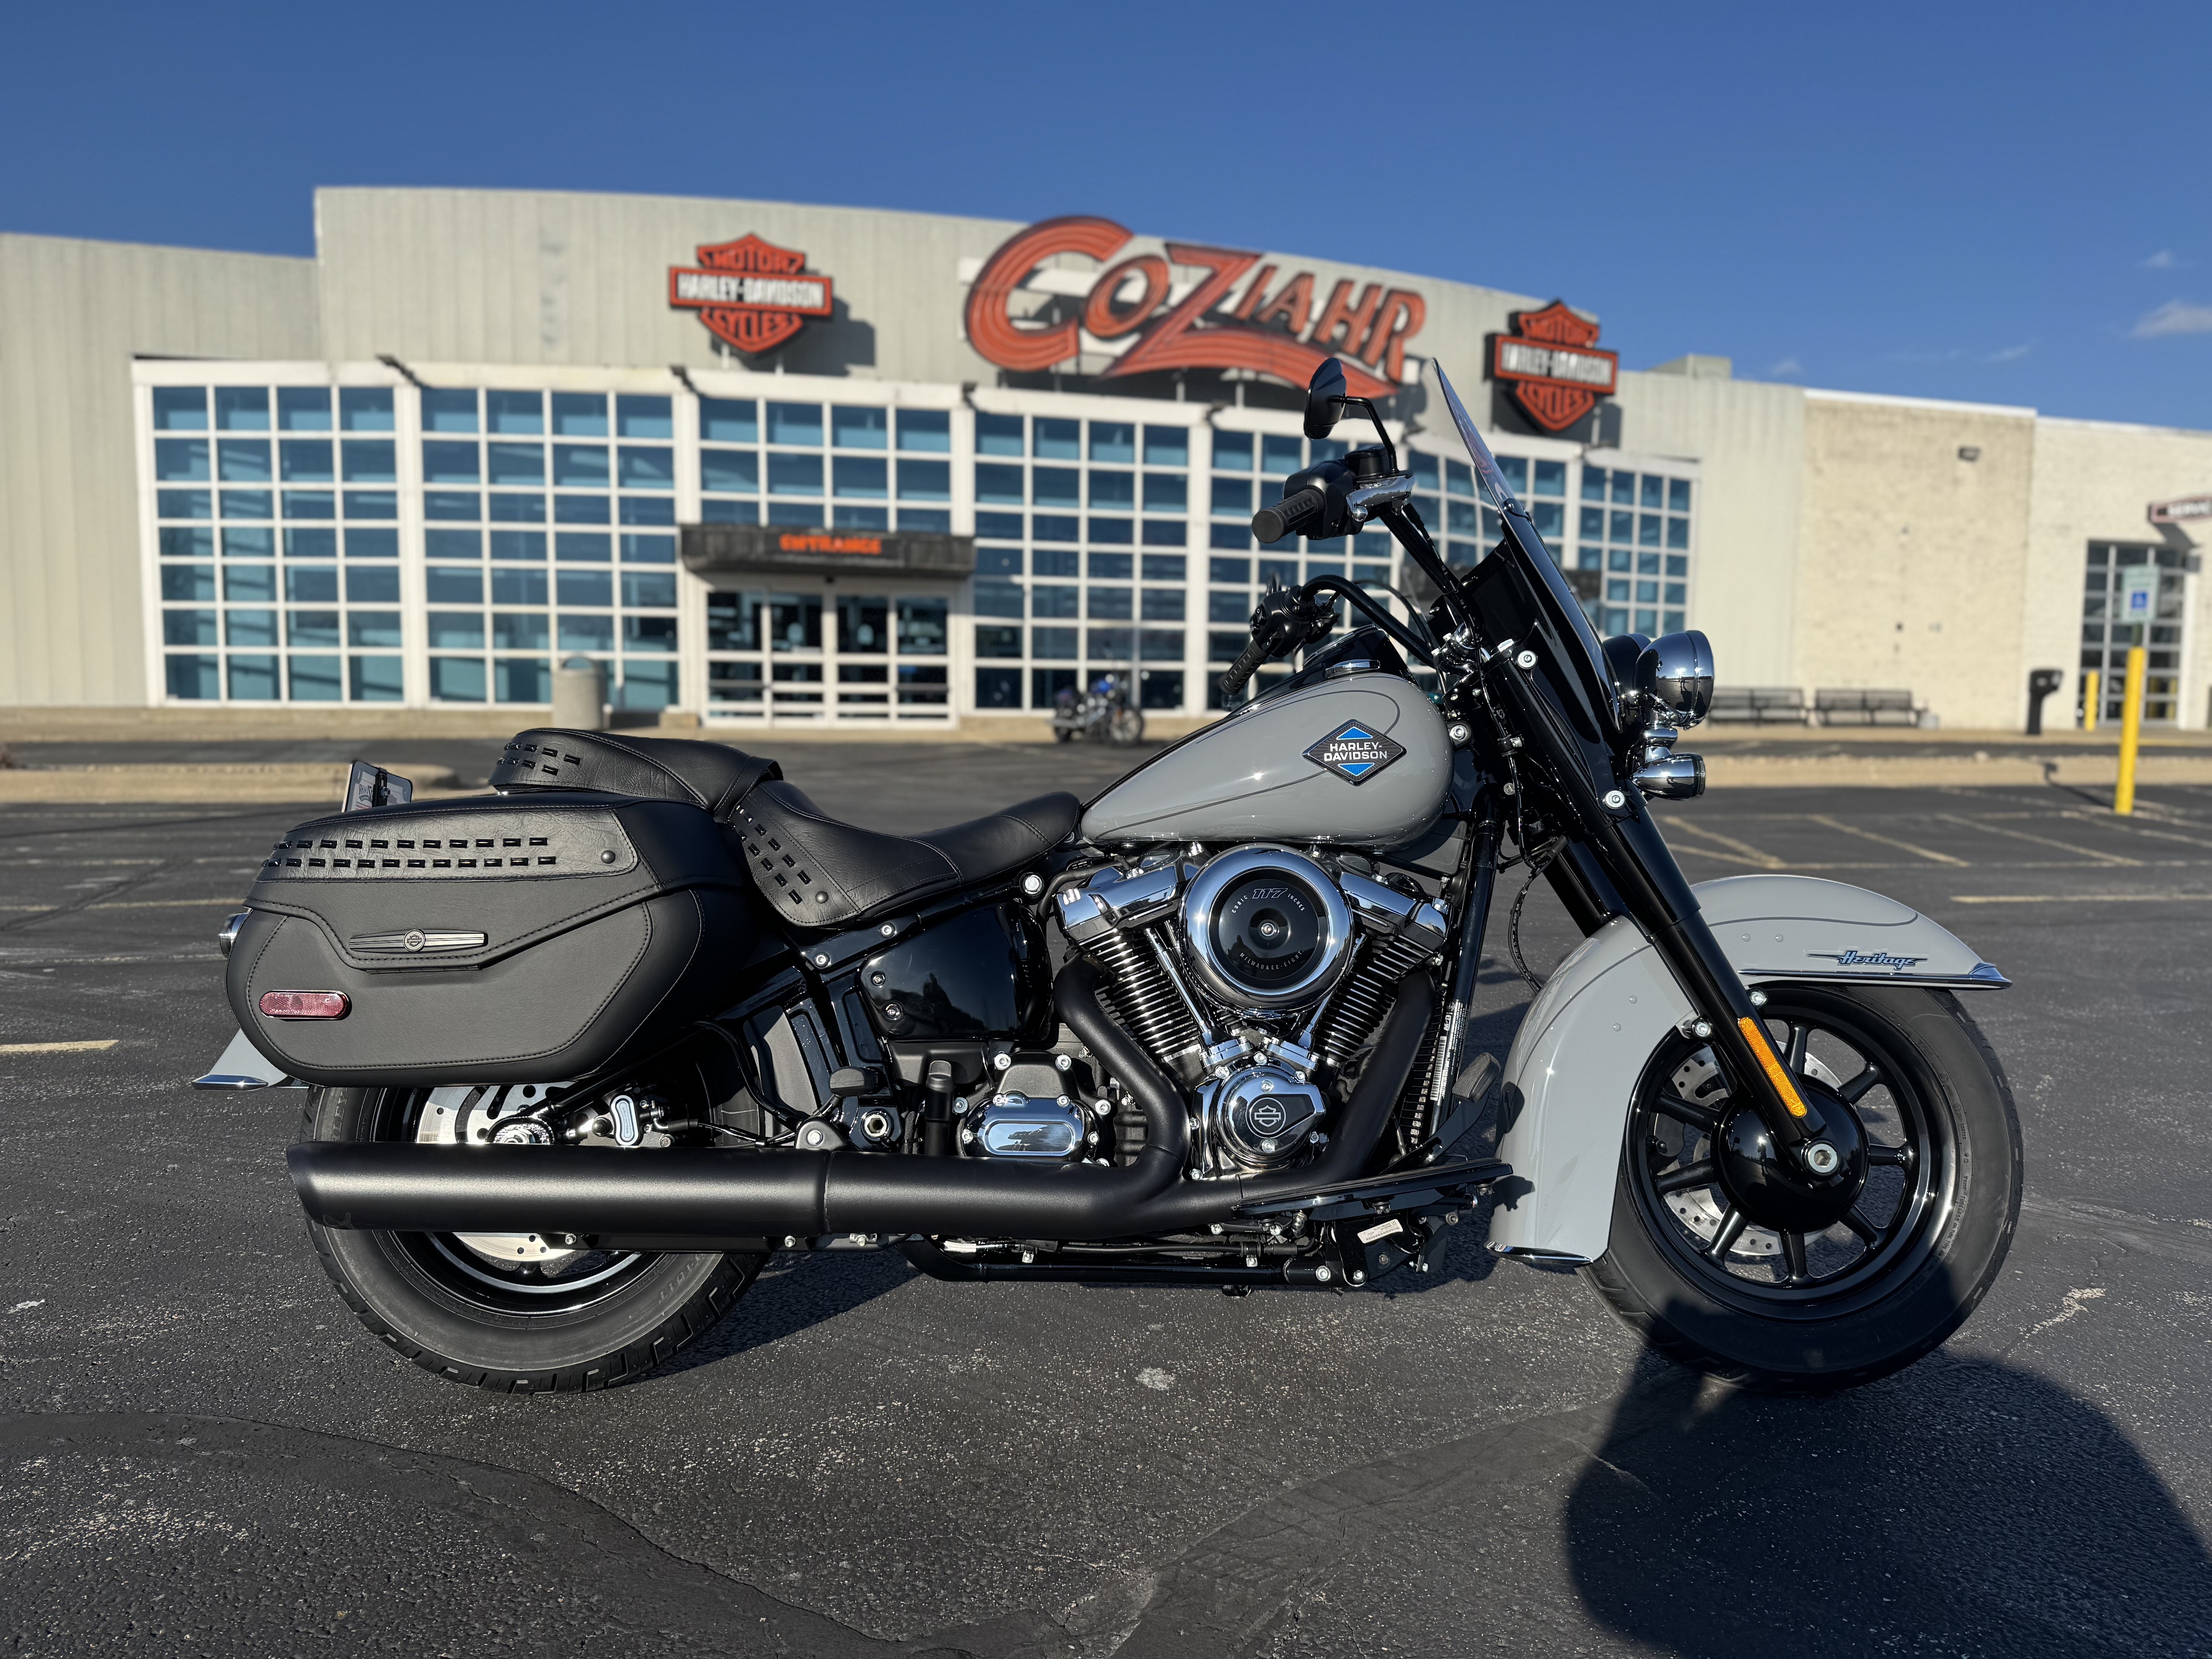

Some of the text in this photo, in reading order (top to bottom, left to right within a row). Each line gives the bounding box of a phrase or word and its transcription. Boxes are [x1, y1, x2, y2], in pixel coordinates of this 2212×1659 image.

[964, 214, 1426, 398] COZIAHR
[1324, 751, 1387, 761] DAVIDSON
[1330, 742, 1382, 752] HARLEY-
[1231, 888, 1305, 913] CUBIC 117 INCHES
[1240, 951, 1302, 970] MILWAUKEE-EIGHT
[1840, 951, 1916, 970] Heritage
